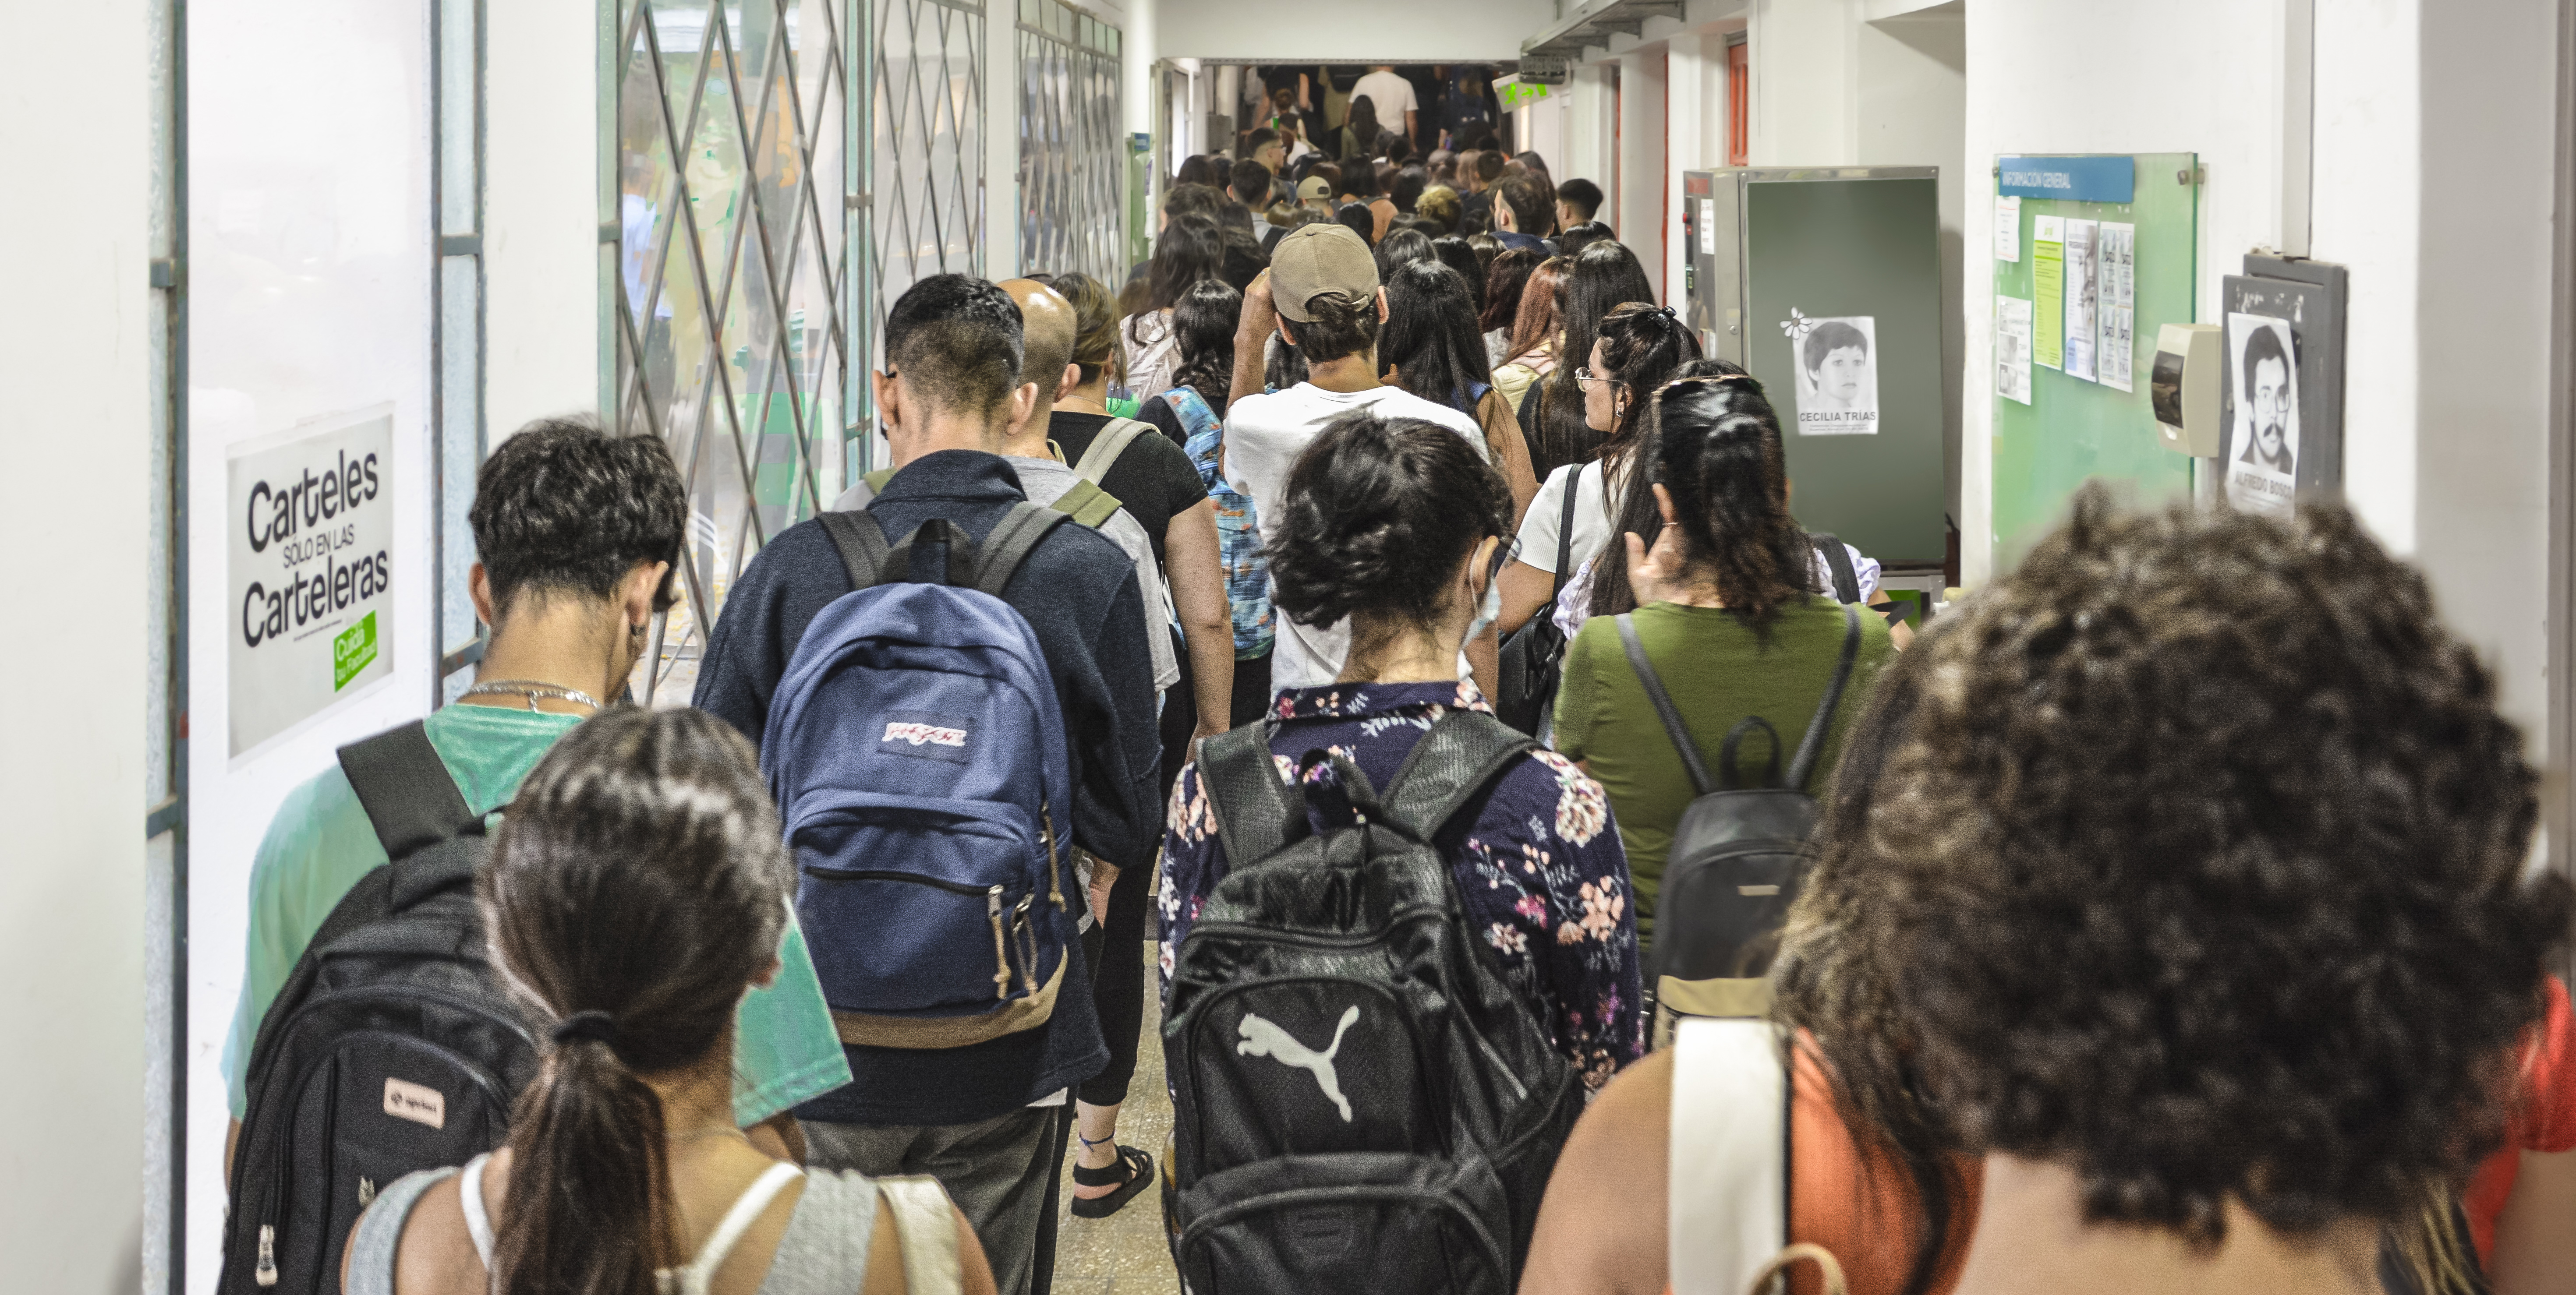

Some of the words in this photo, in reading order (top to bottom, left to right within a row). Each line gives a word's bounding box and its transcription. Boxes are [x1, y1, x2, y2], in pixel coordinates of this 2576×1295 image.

[2043, 172, 2071, 189] GENERAL
[1800, 412, 1841, 422] CECILIA
[1845, 409, 1876, 420] TRÍAS
[248, 449, 378, 552] Carteles
[2235, 471, 2268, 492] ALFREDO
[2270, 480, 2292, 501] BOSCO
[283, 534, 313, 569] SÓLO
[316, 530, 331, 556] EN
[333, 523, 354, 550] LAS
[243, 550, 388, 648] Carteleras
